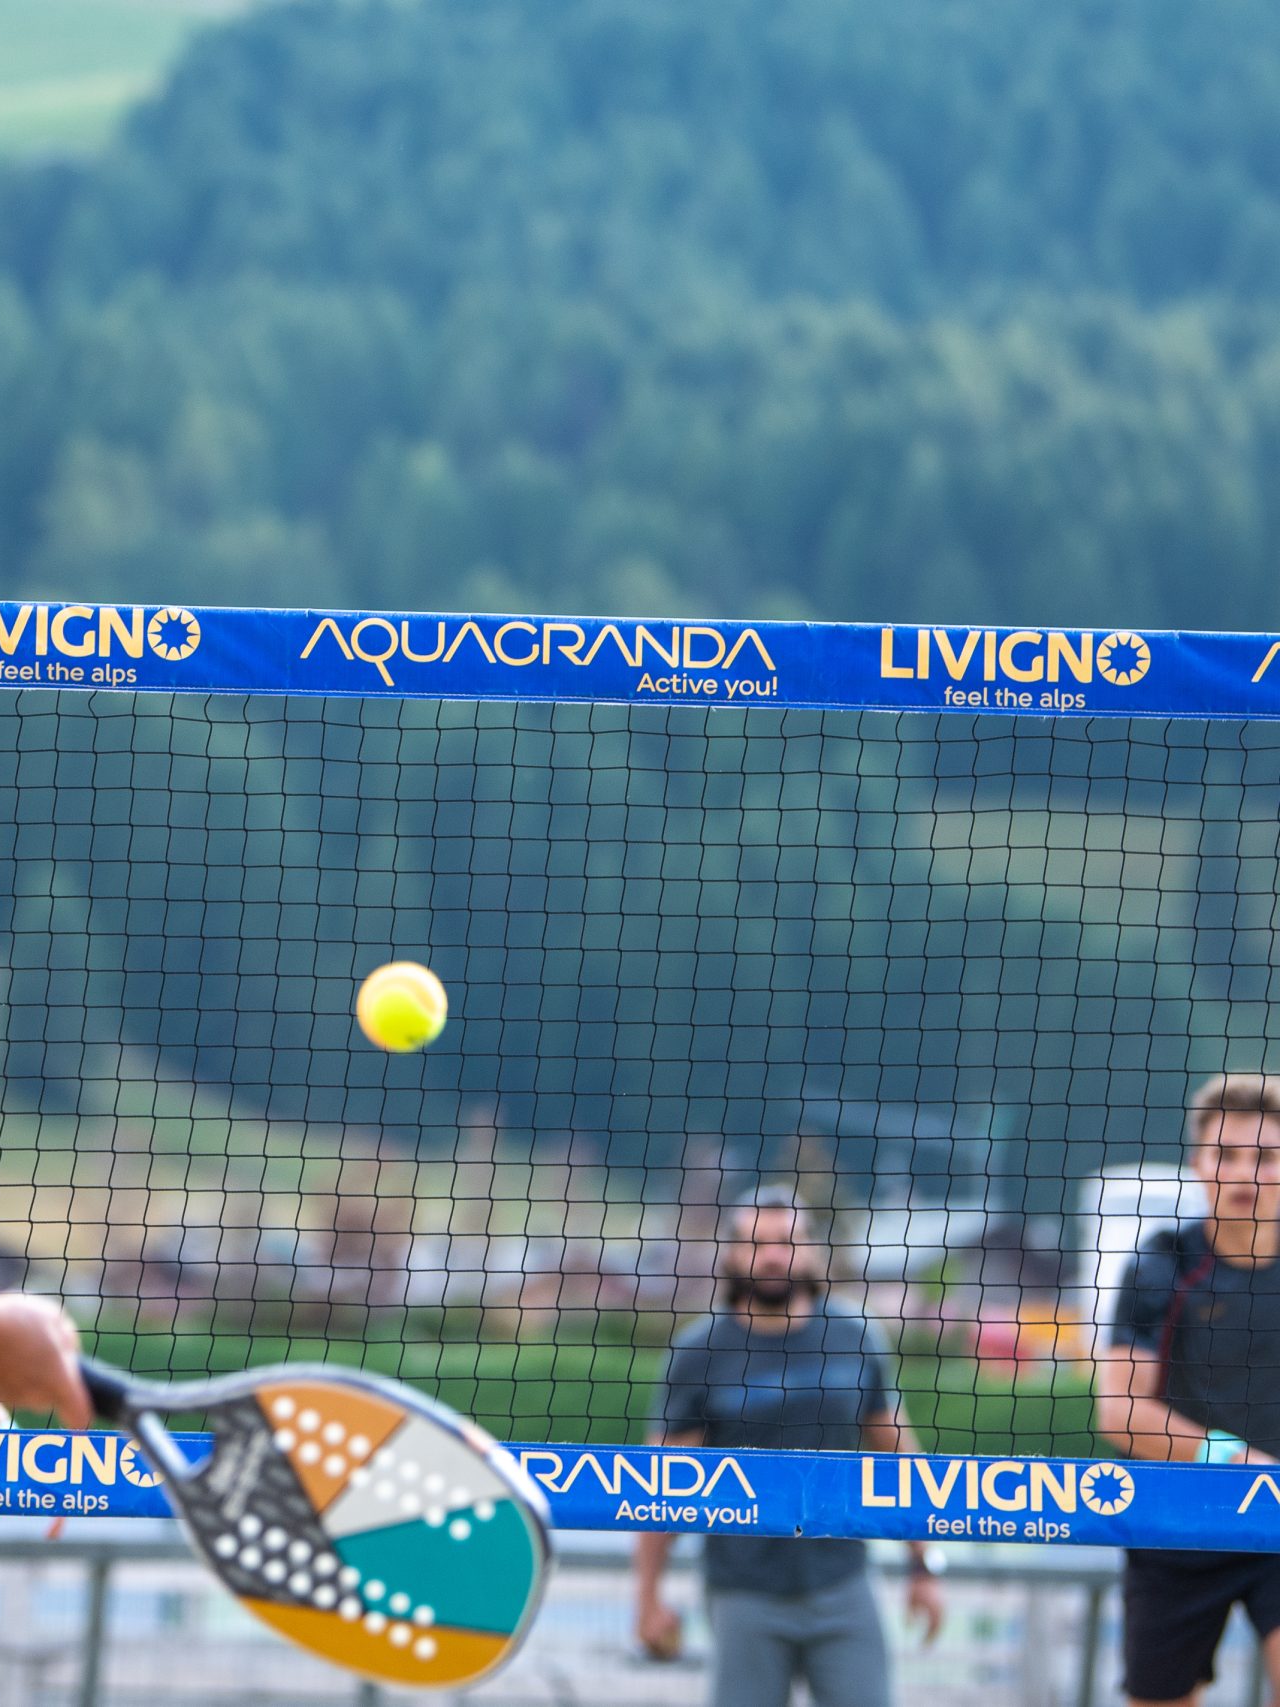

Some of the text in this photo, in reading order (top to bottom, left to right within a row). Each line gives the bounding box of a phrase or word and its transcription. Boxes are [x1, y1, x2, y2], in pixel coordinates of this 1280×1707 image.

[301, 617, 776, 687] AQUAGRANDA
[880, 628, 1152, 686] LIVIGNO
[46, 662, 85, 682] the
[91, 663, 137, 689] alps
[636, 672, 778, 700] Active you!
[944, 685, 1086, 714] feel the alps
[860, 1456, 1135, 1516] LIVIGNO
[16, 1488, 57, 1509] the
[62, 1489, 109, 1516] alps
[615, 1499, 759, 1529] Active you!
[926, 1514, 1071, 1543] feel the alps
